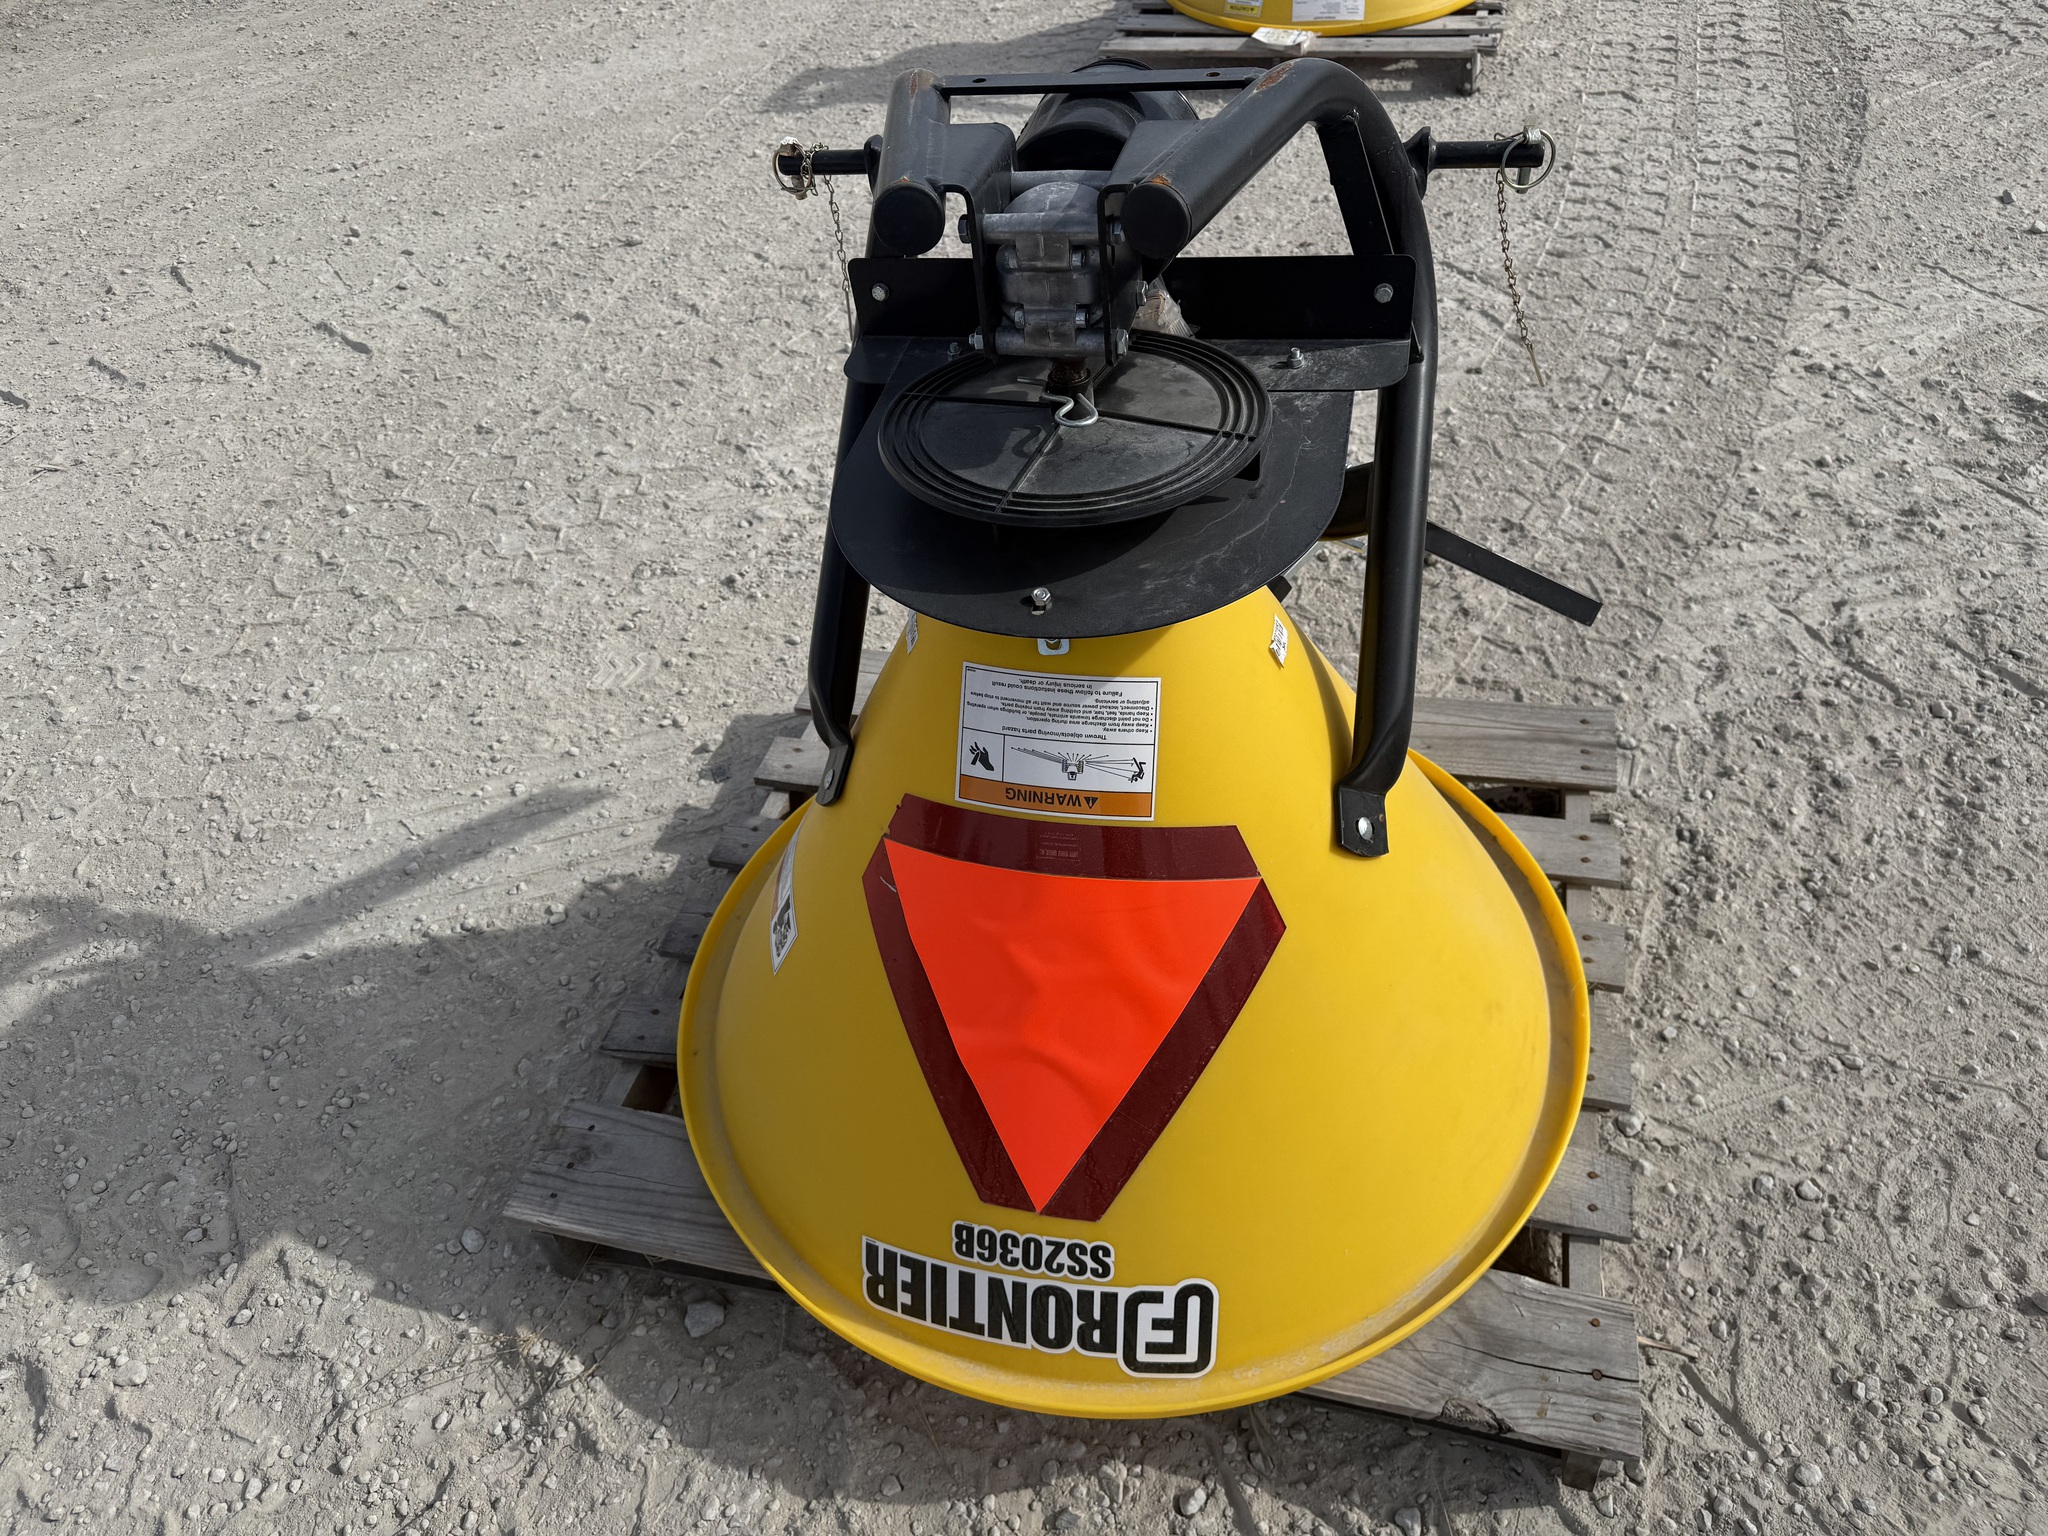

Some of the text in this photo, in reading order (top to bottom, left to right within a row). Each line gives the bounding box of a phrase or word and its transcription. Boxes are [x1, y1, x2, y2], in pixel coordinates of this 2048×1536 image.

[1038, 729, 1083, 739] objects/moving
[1005, 787, 1082, 808] WARNING
[955, 1222, 1111, 1278] SS2036B
[865, 1241, 1213, 1373] FRONTIER
